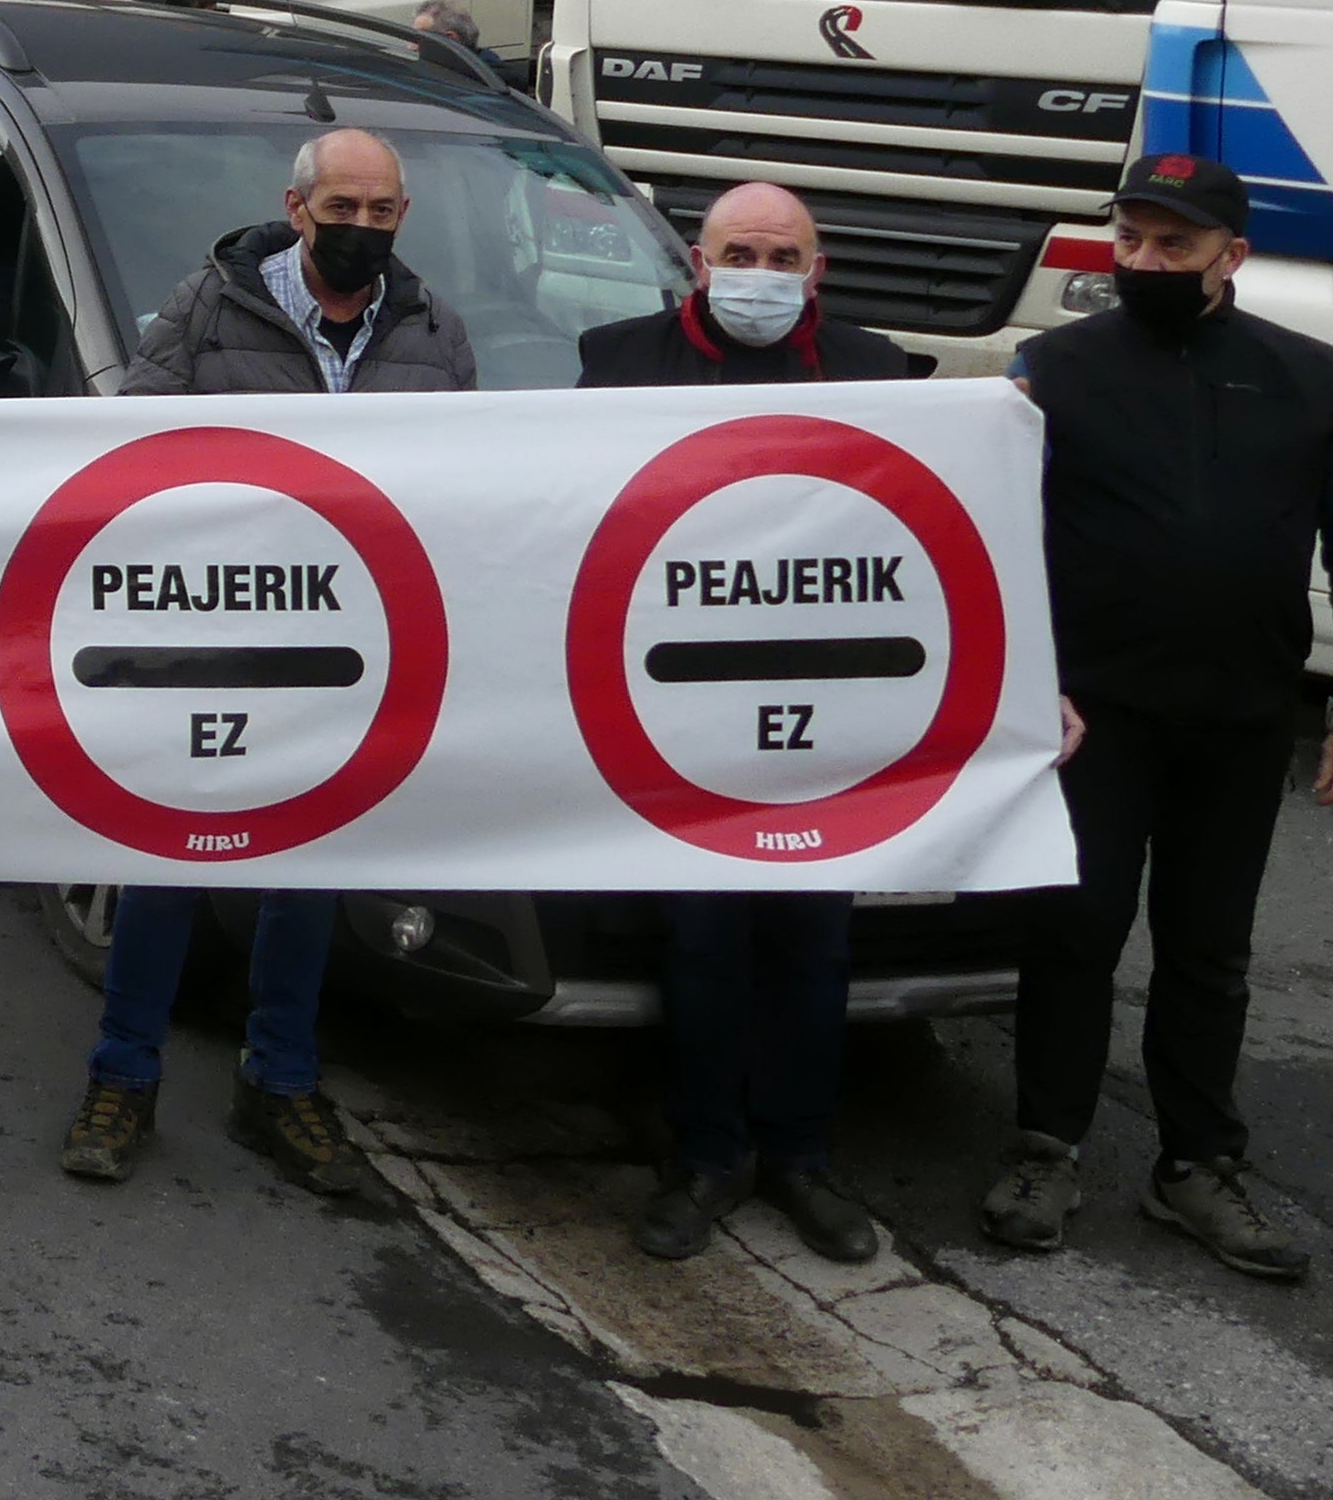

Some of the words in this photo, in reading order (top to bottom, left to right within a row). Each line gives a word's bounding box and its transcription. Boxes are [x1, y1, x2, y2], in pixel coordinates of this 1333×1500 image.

[601, 57, 703, 83] DAF
[1037, 88, 1130, 114] CF
[92, 564, 342, 611] PEAJERIK
[665, 556, 905, 607] PEAJERIK
[190, 713, 248, 758] EZ
[758, 704, 814, 750] EZ
